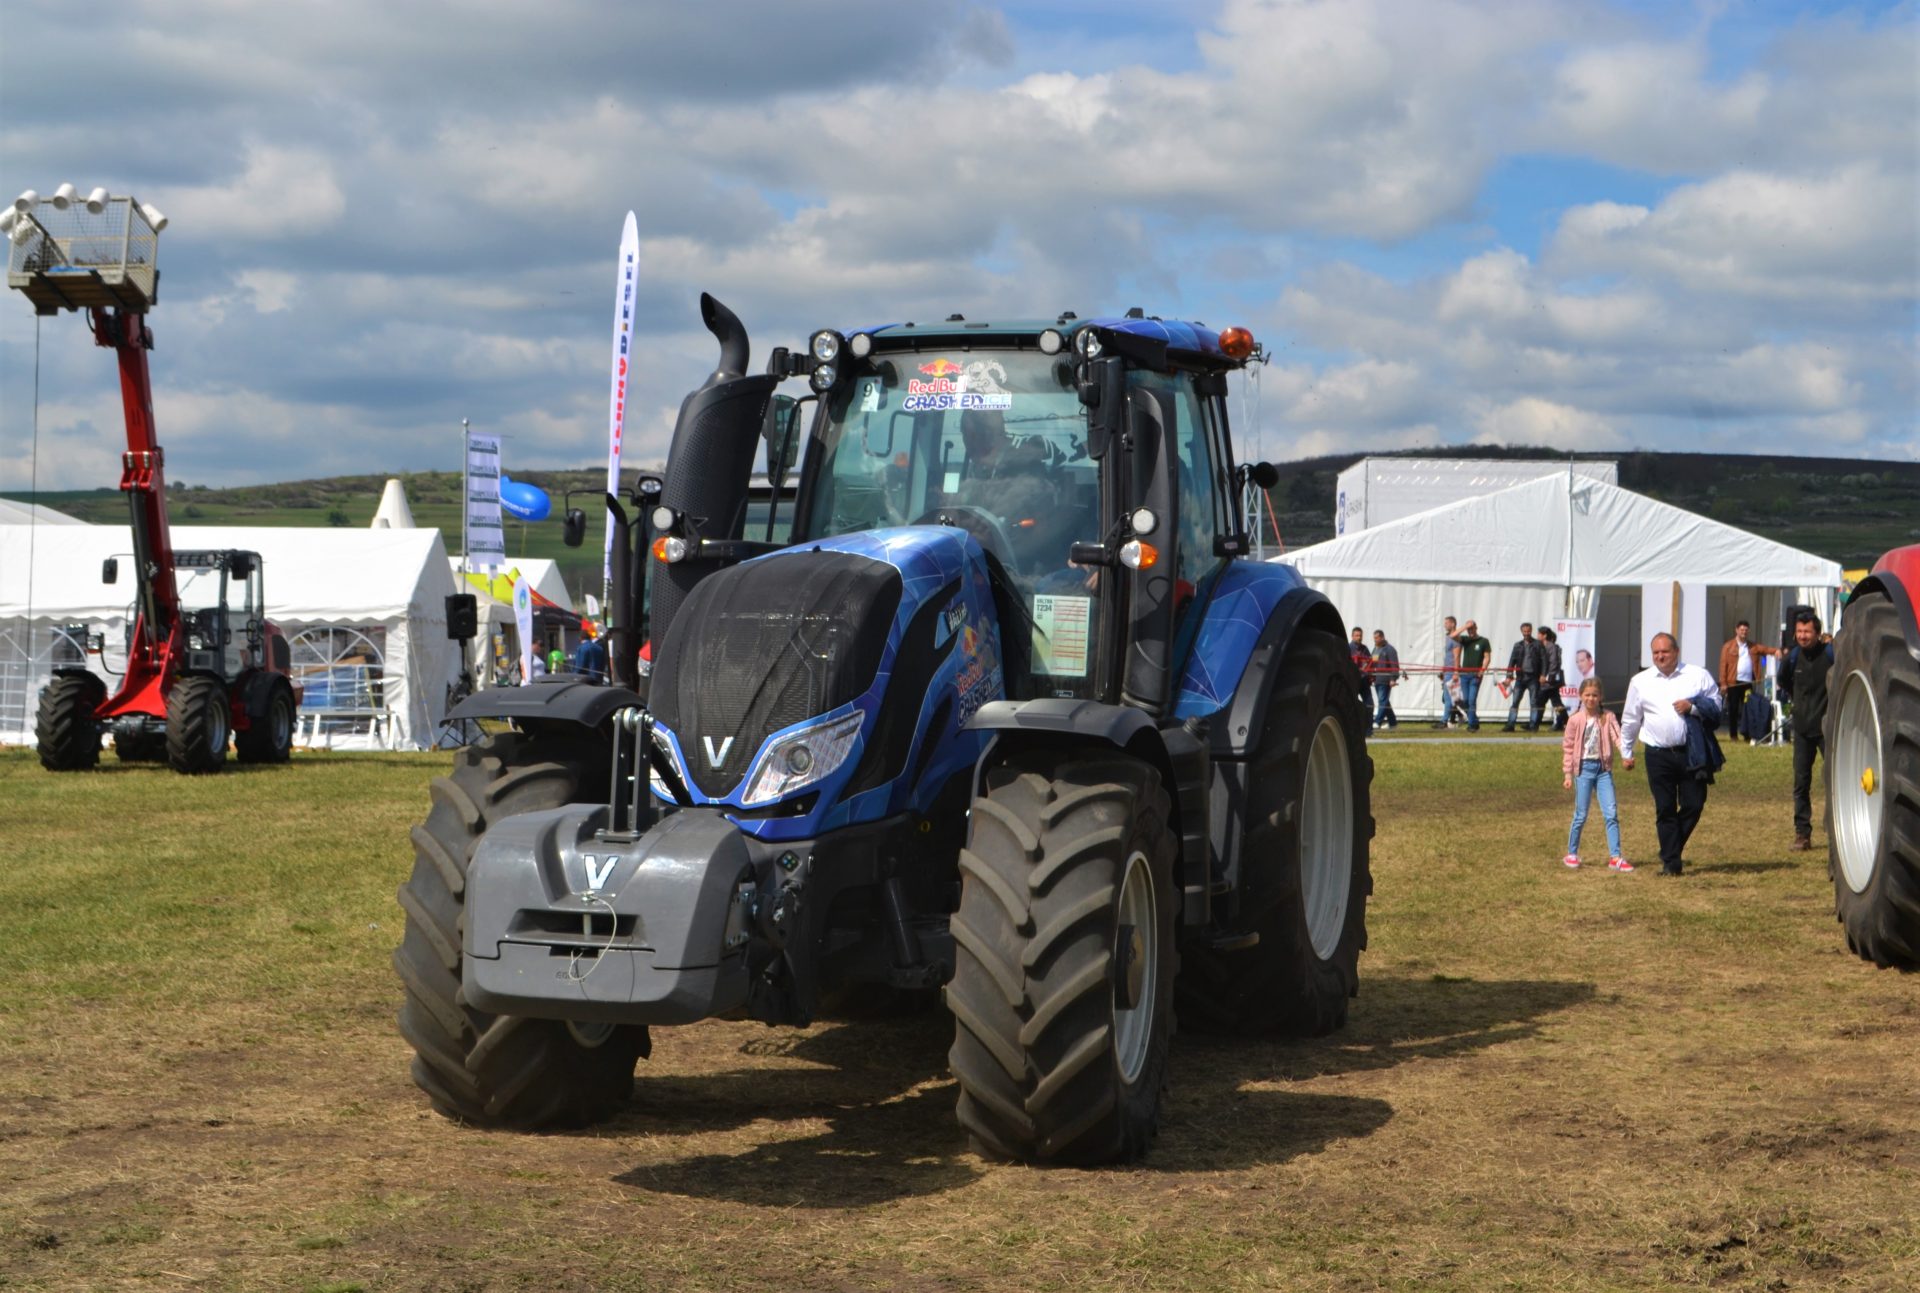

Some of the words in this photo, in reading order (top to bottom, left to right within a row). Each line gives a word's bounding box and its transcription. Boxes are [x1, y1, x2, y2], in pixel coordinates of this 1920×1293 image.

[908, 379, 938, 394] Red
[903, 393, 984, 410] CRASHED
[703, 736, 734, 769] V
[584, 855, 618, 889] V
